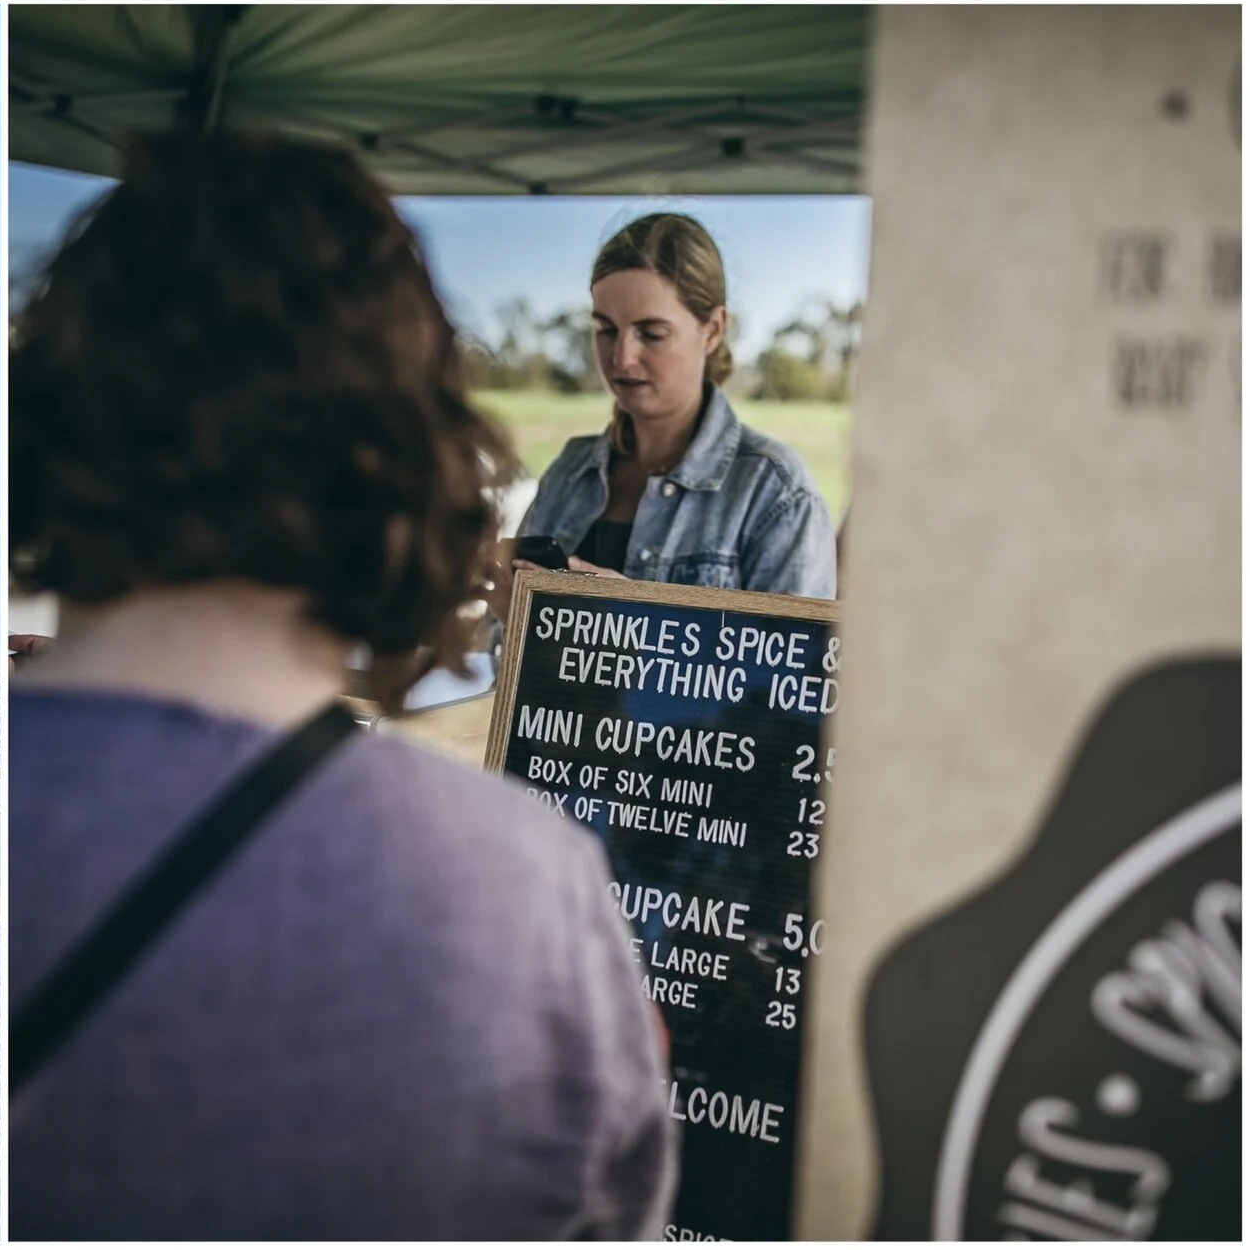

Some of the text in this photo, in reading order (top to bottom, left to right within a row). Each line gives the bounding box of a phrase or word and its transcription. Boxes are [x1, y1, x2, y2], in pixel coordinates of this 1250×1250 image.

[535, 606, 842, 674] SPRINKLES SPICE &
[558, 646, 840, 714] EVERYTHING ICED
[517, 705, 583, 748] MINI
[595, 717, 756, 773] CUPCAKES
[527, 755, 826, 826] BOX OF SIX MINI 12
[574, 796, 604, 823] OF
[607, 800, 693, 838] TWELVE
[697, 816, 748, 848] MINI
[786, 831, 820, 859] 23
[650, 940, 730, 982] LARGE
[774, 966, 801, 995] 13
[640, 974, 797, 1030] ARGE 25
[659, 1079, 785, 1144] LCOME
